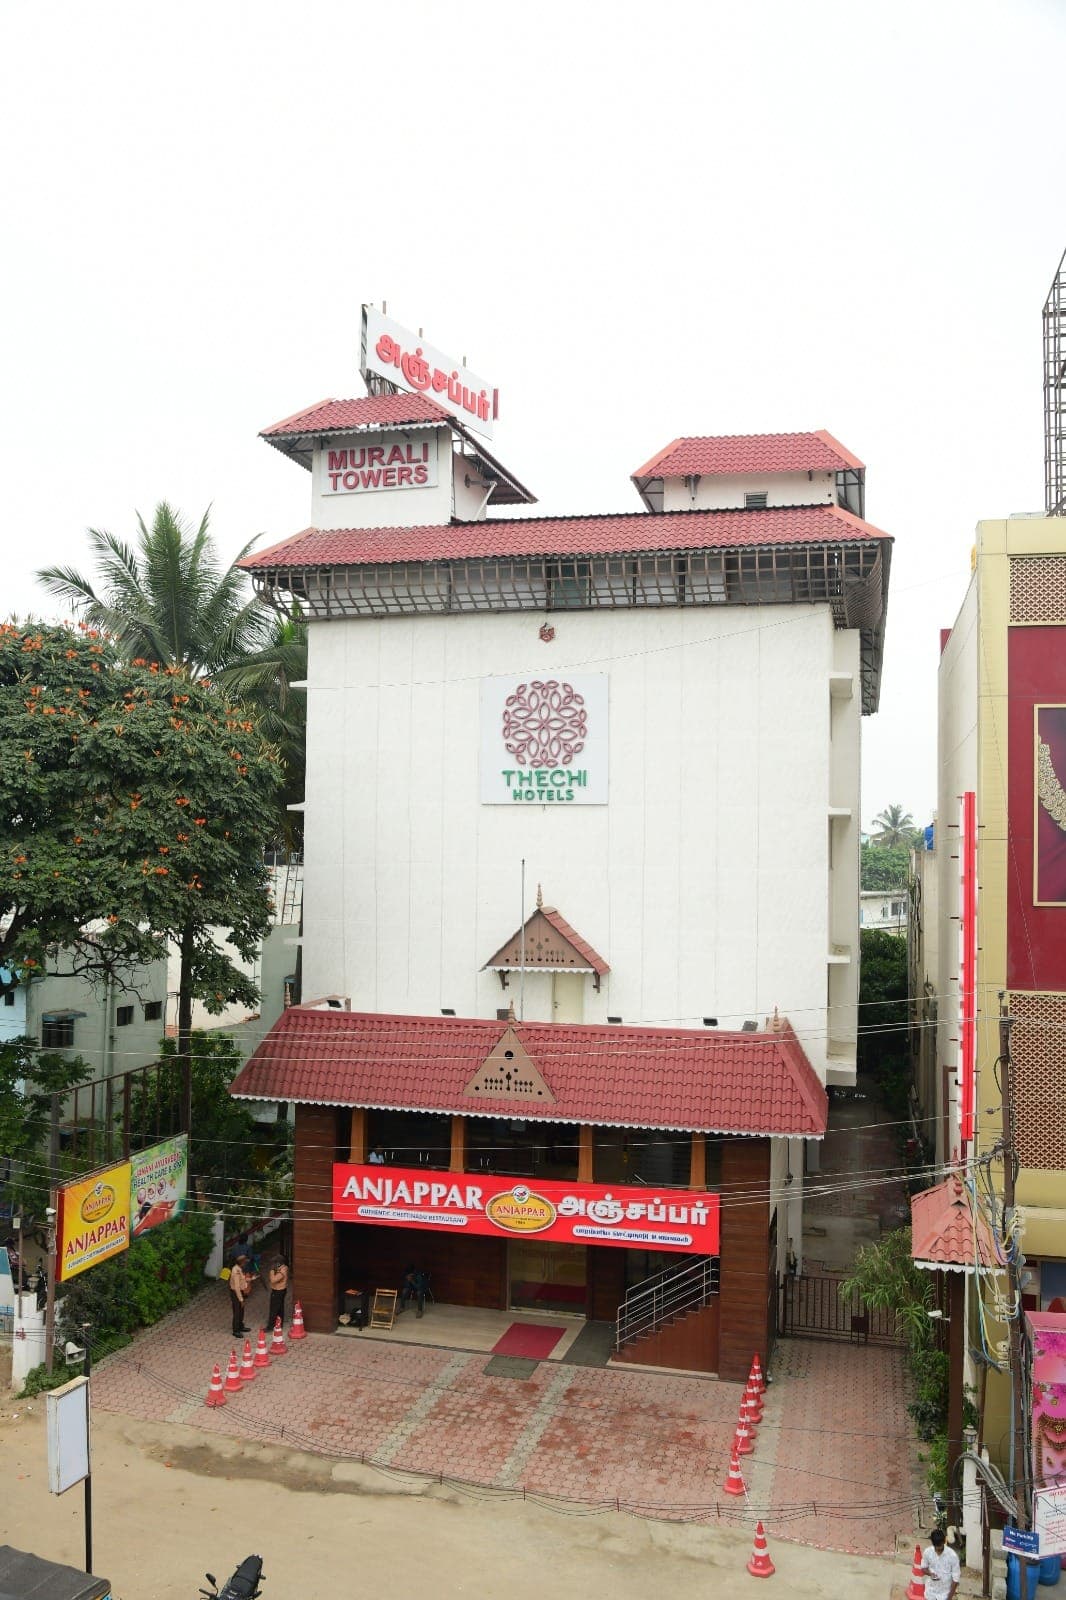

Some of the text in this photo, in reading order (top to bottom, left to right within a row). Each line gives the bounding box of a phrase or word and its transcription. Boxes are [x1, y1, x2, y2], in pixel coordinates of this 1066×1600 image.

[376, 334, 490, 421] அஞ்சப்பர்
[328, 442, 429, 470] MURALI
[328, 465, 428, 491] TOWERS
[502, 769, 587, 787] THECHI
[513, 789, 574, 801] HOTELS
[133, 1173, 154, 1188] HEALTH
[342, 1175, 484, 1210] ANJAPPAR
[496, 1206, 545, 1216] ANJAPPAR
[558, 1193, 708, 1226] அஞ்சப்பர்
[65, 1215, 126, 1258] ANJAPPAR
